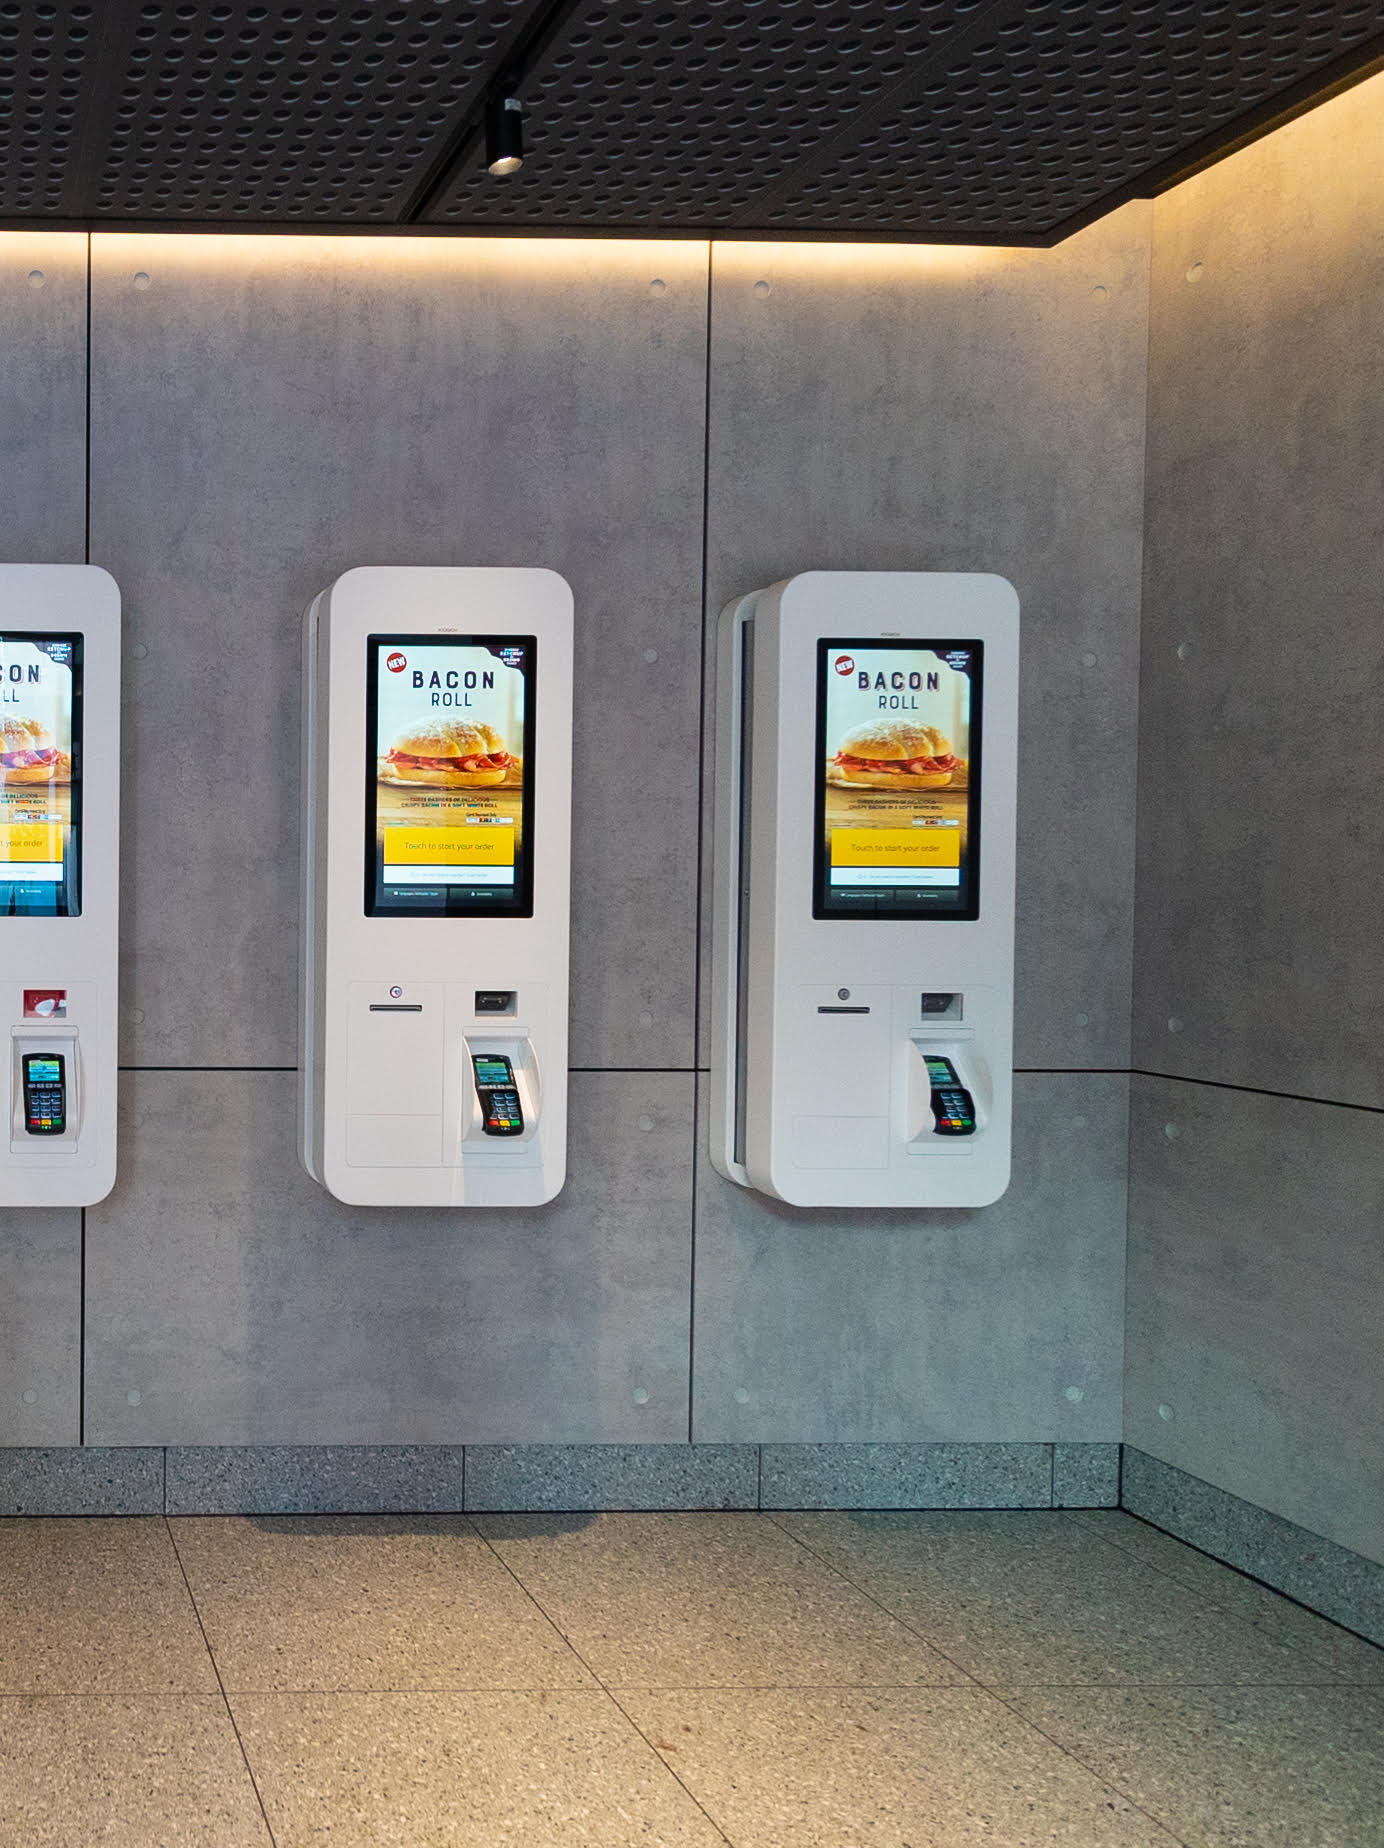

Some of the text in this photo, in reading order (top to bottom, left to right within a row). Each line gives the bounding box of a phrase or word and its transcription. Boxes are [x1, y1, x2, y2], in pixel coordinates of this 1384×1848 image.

[388, 656, 406, 670] NEW
[412, 670, 495, 689] BACON
[858, 671, 940, 691] BACON
[431, 692, 472, 706] ROLL
[878, 695, 919, 710] ROLL
[404, 842, 427, 850] Touch
[457, 843, 473, 851] your
[851, 844, 874, 852] Touch
